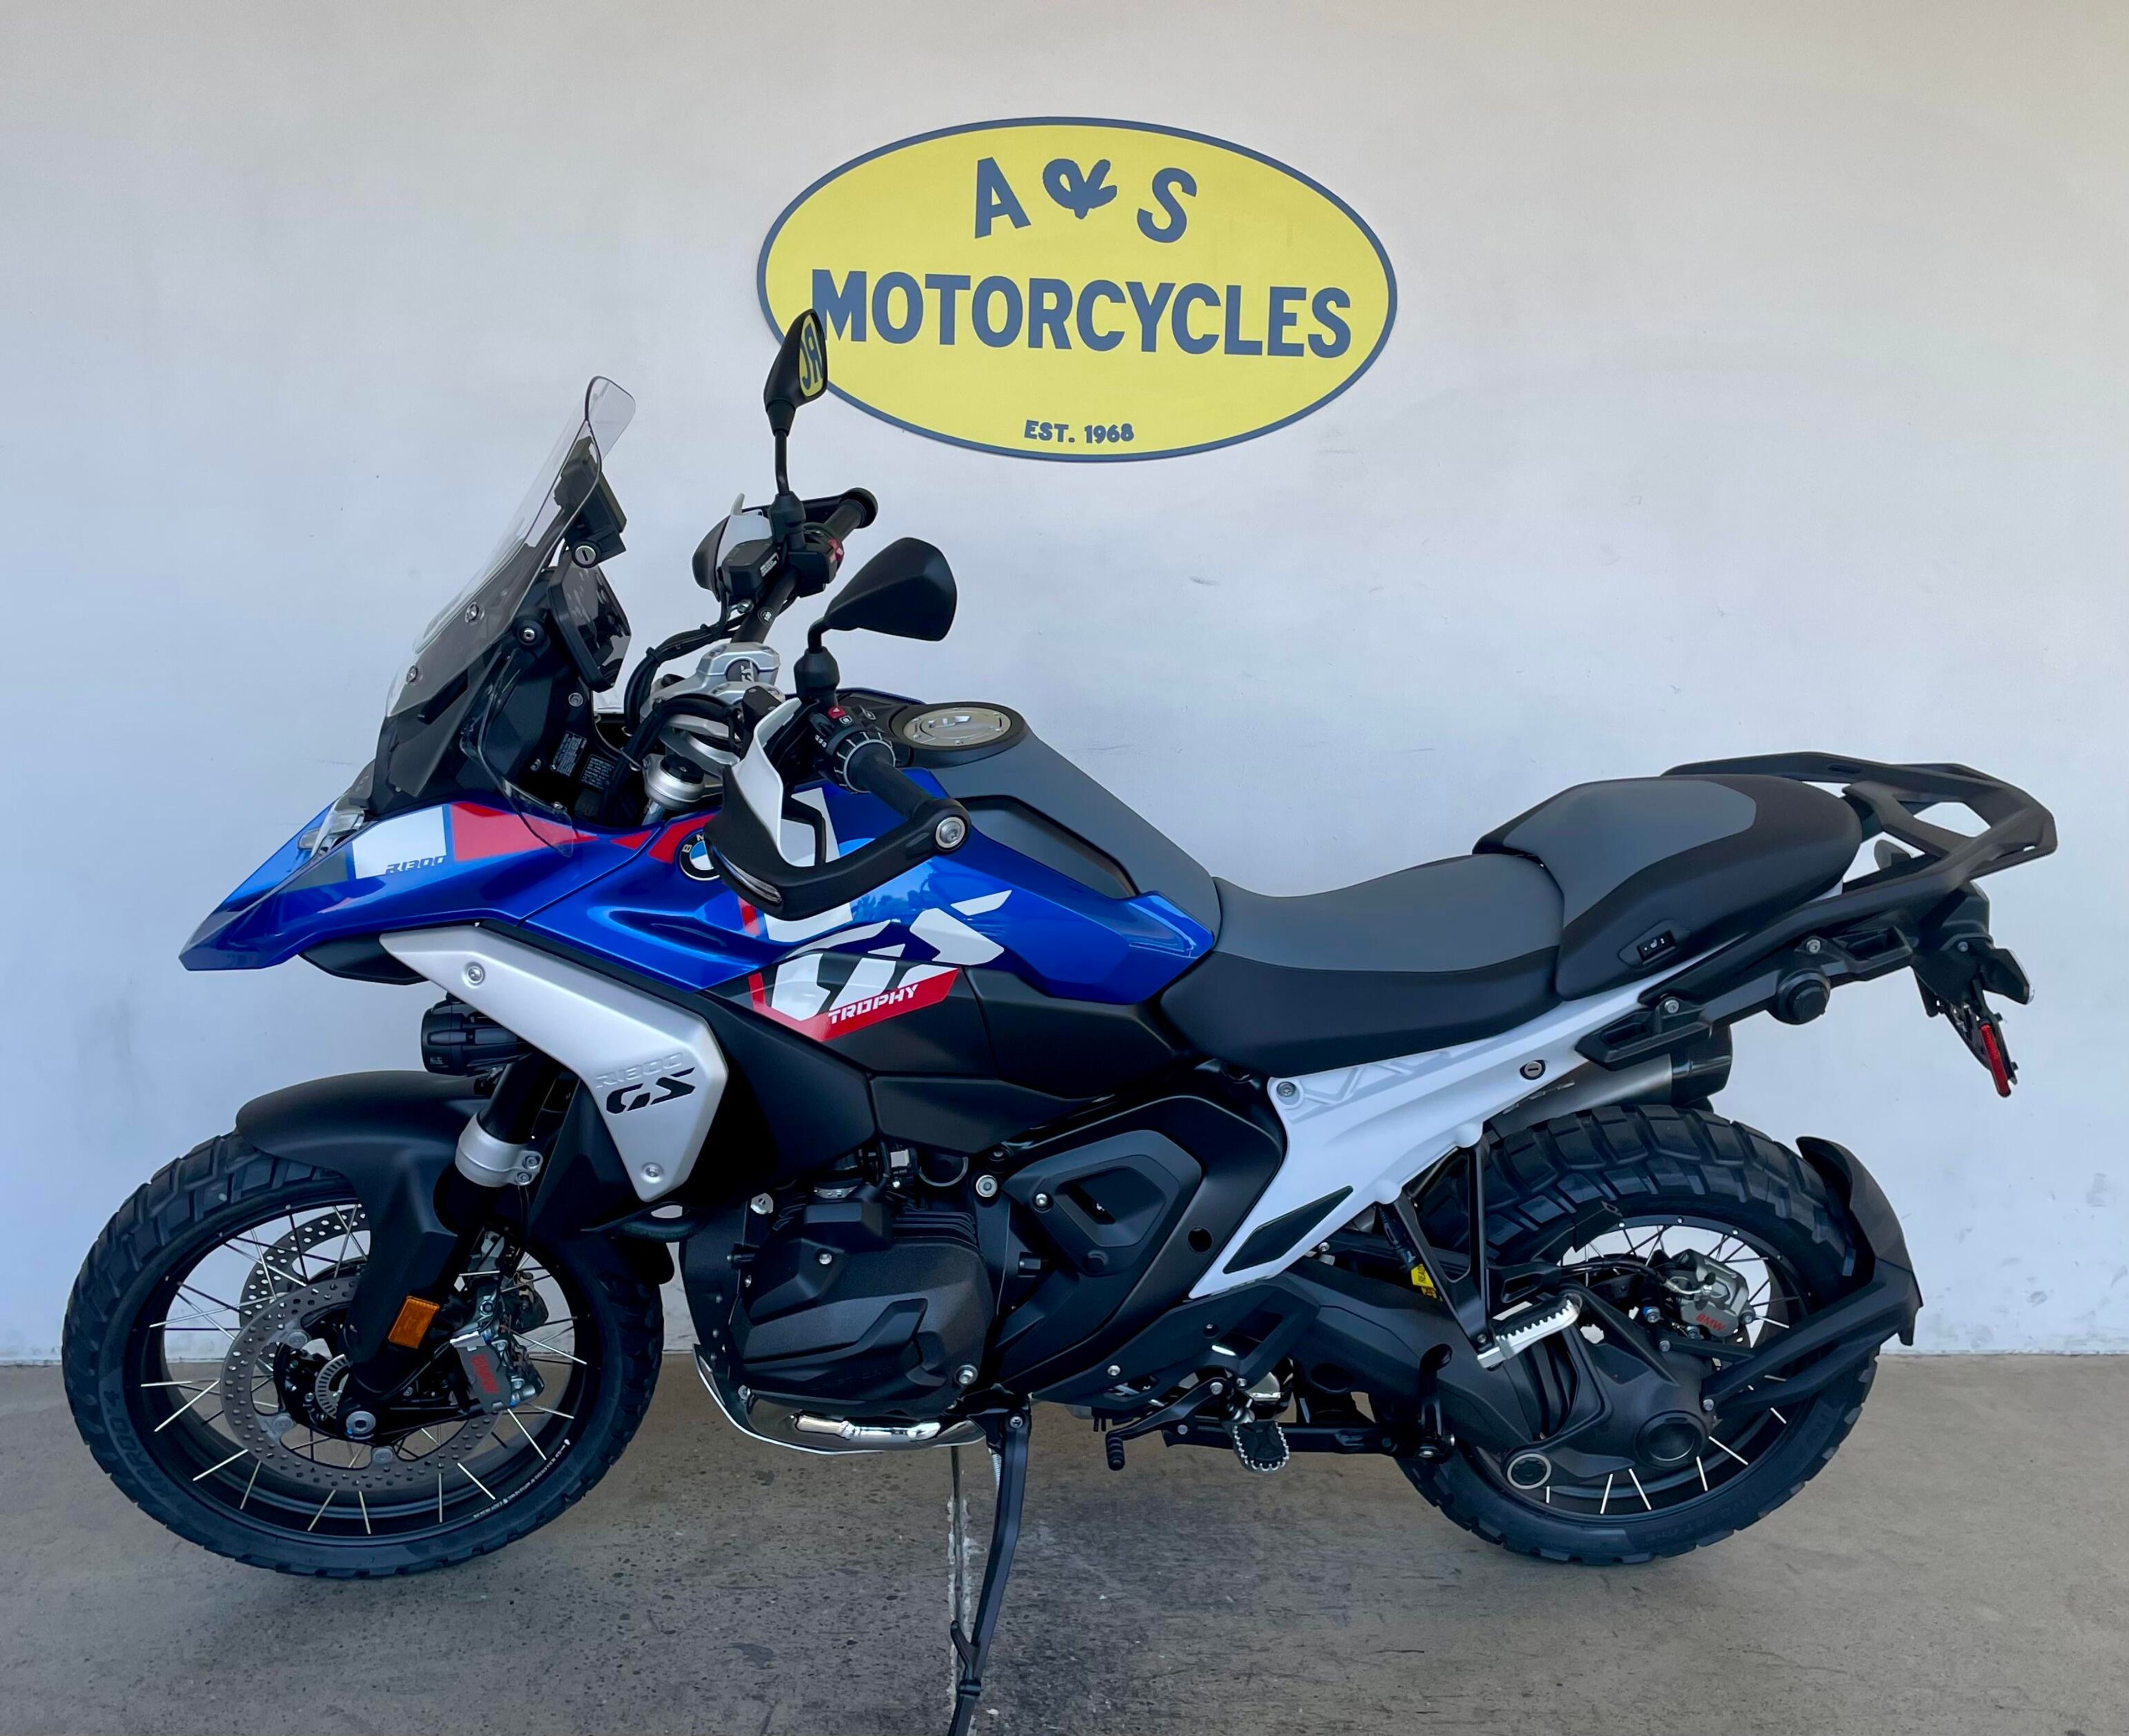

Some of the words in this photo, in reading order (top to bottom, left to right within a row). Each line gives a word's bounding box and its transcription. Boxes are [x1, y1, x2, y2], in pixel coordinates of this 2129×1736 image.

[975, 158, 1030, 238] A
[1137, 167, 1196, 243] S
[812, 269, 1351, 358] MOTORCYCLES
[1024, 420, 1075, 443] EST.
[1084, 423, 1134, 443] 1968
[385, 855, 445, 875] R1300
[828, 984, 919, 1024] TROPHY
[605, 1066, 696, 1115] GS
[1695, 1312, 1728, 1331] BMW
